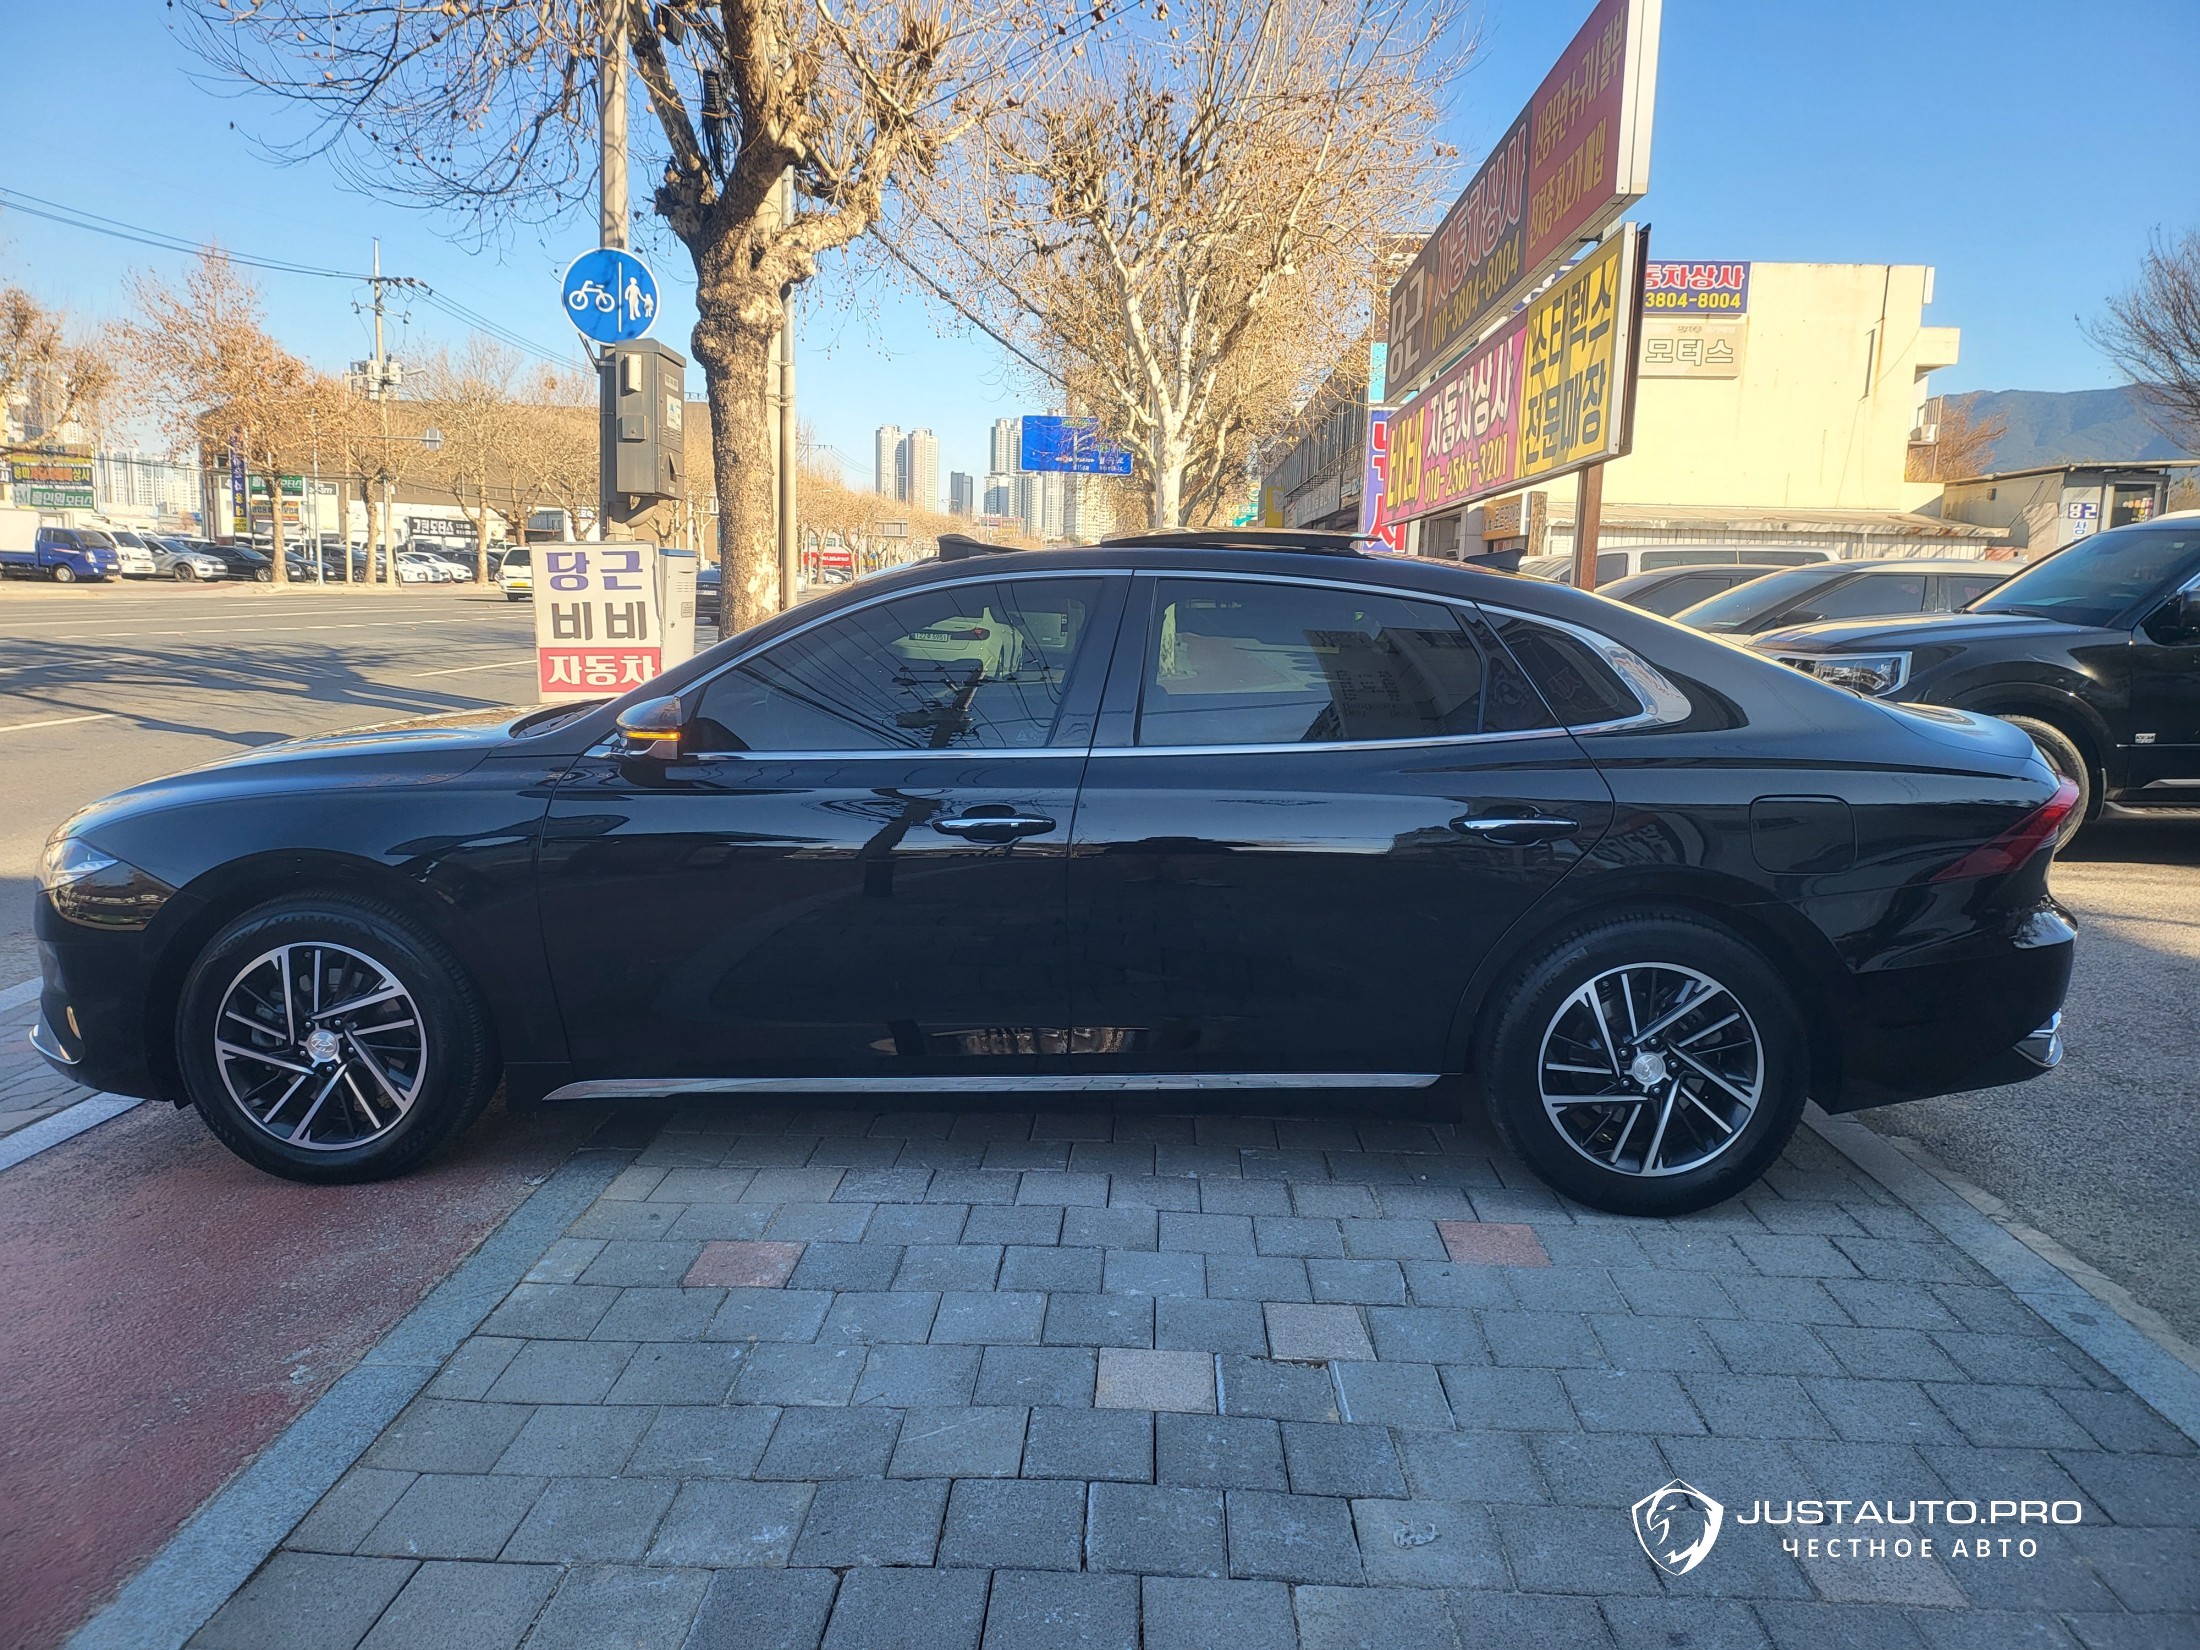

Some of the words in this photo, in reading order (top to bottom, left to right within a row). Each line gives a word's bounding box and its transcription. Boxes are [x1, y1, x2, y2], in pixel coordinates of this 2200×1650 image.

[1534, 75, 1571, 170] 신용무관
[1570, 36, 1601, 128] 누구나
[1600, 5, 1625, 94] 할부
[1434, 121, 1527, 308] 자동차상사
[1554, 142, 1584, 222] 최고가
[1583, 117, 1607, 194] 매입
[1388, 264, 1427, 384] 당근
[1431, 229, 1520, 351] 010-3804-8004
[1530, 260, 1612, 377] 스타렉스
[1645, 292, 1742, 308] 3804-8004
[1427, 335, 1514, 459] 자동차상사
[1645, 339, 1734, 366] 모터스
[1386, 406, 1426, 509] 비비
[1526, 358, 1606, 465] 전문매장
[1424, 433, 1509, 505] 010-2566-3201
[2070, 504, 2097, 518] 당근
[546, 551, 643, 591] 당근
[551, 601, 647, 641] 비비
[548, 655, 655, 686] 자동차
